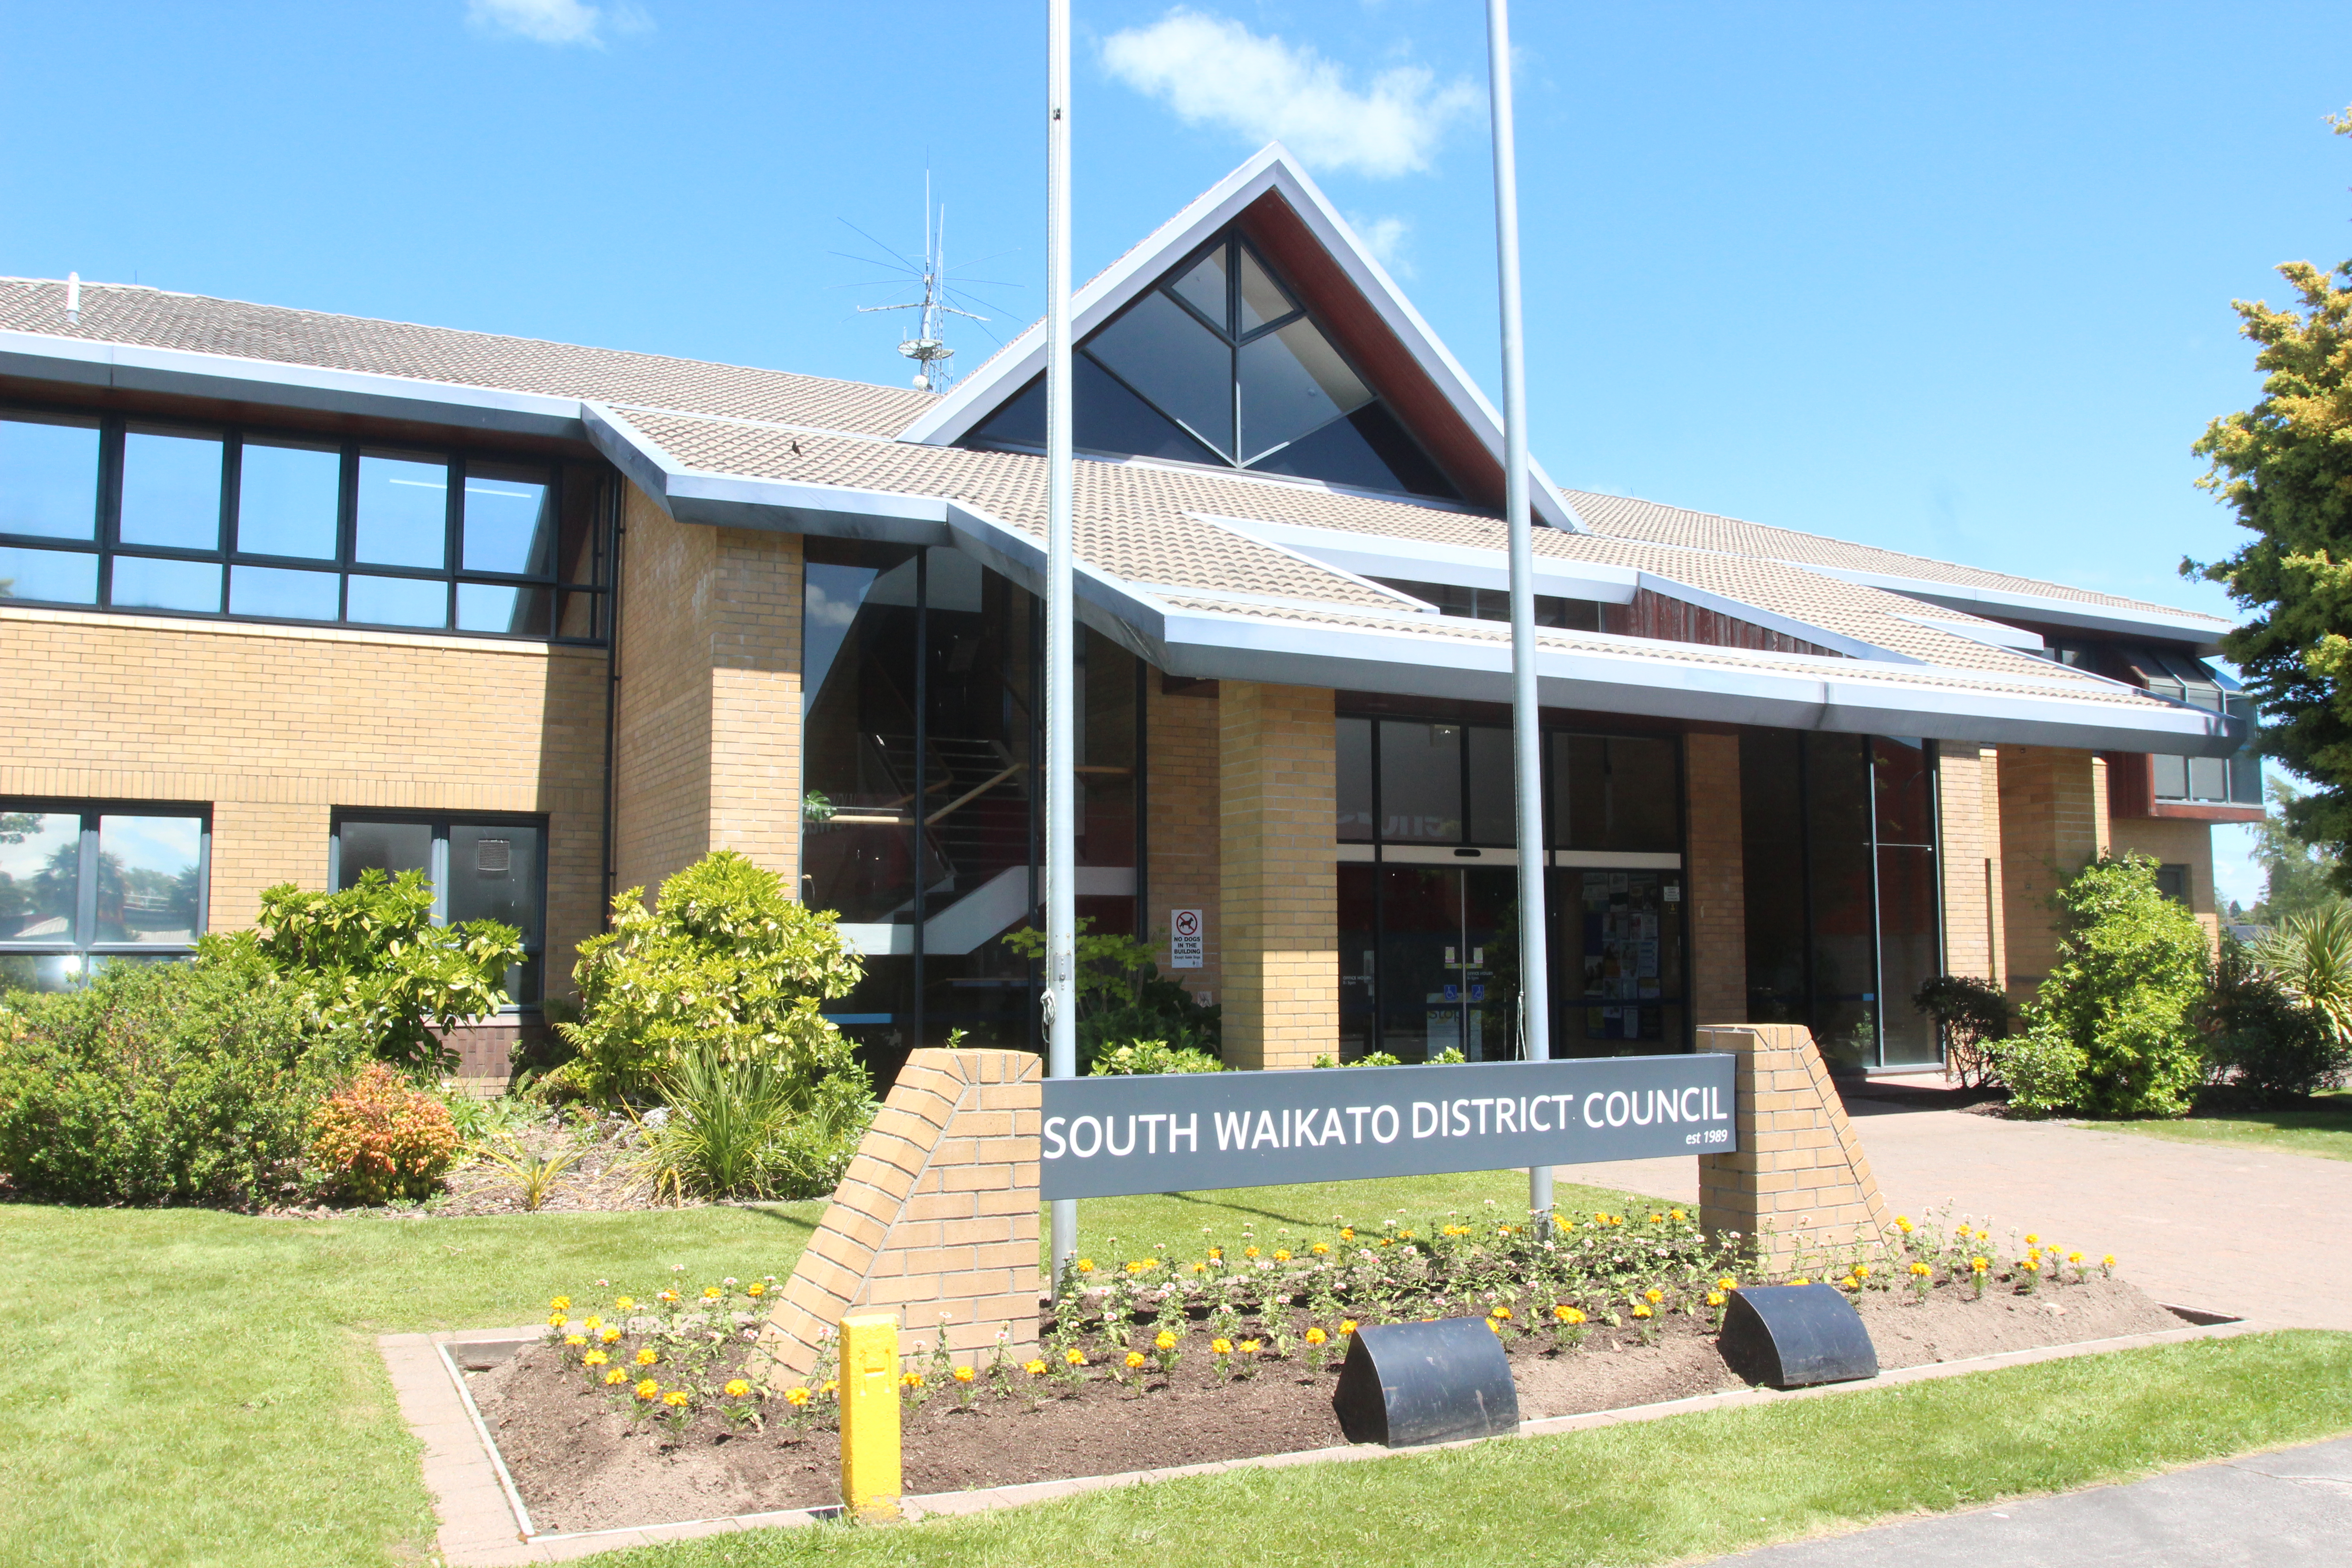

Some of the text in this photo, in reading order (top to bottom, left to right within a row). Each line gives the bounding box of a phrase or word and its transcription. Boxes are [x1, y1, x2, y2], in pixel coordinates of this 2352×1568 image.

[1042, 1086, 1728, 1160] SOUTH WAIKATO DISTRICT COUNCIL
[1686, 1129, 1728, 1145] est 1989
